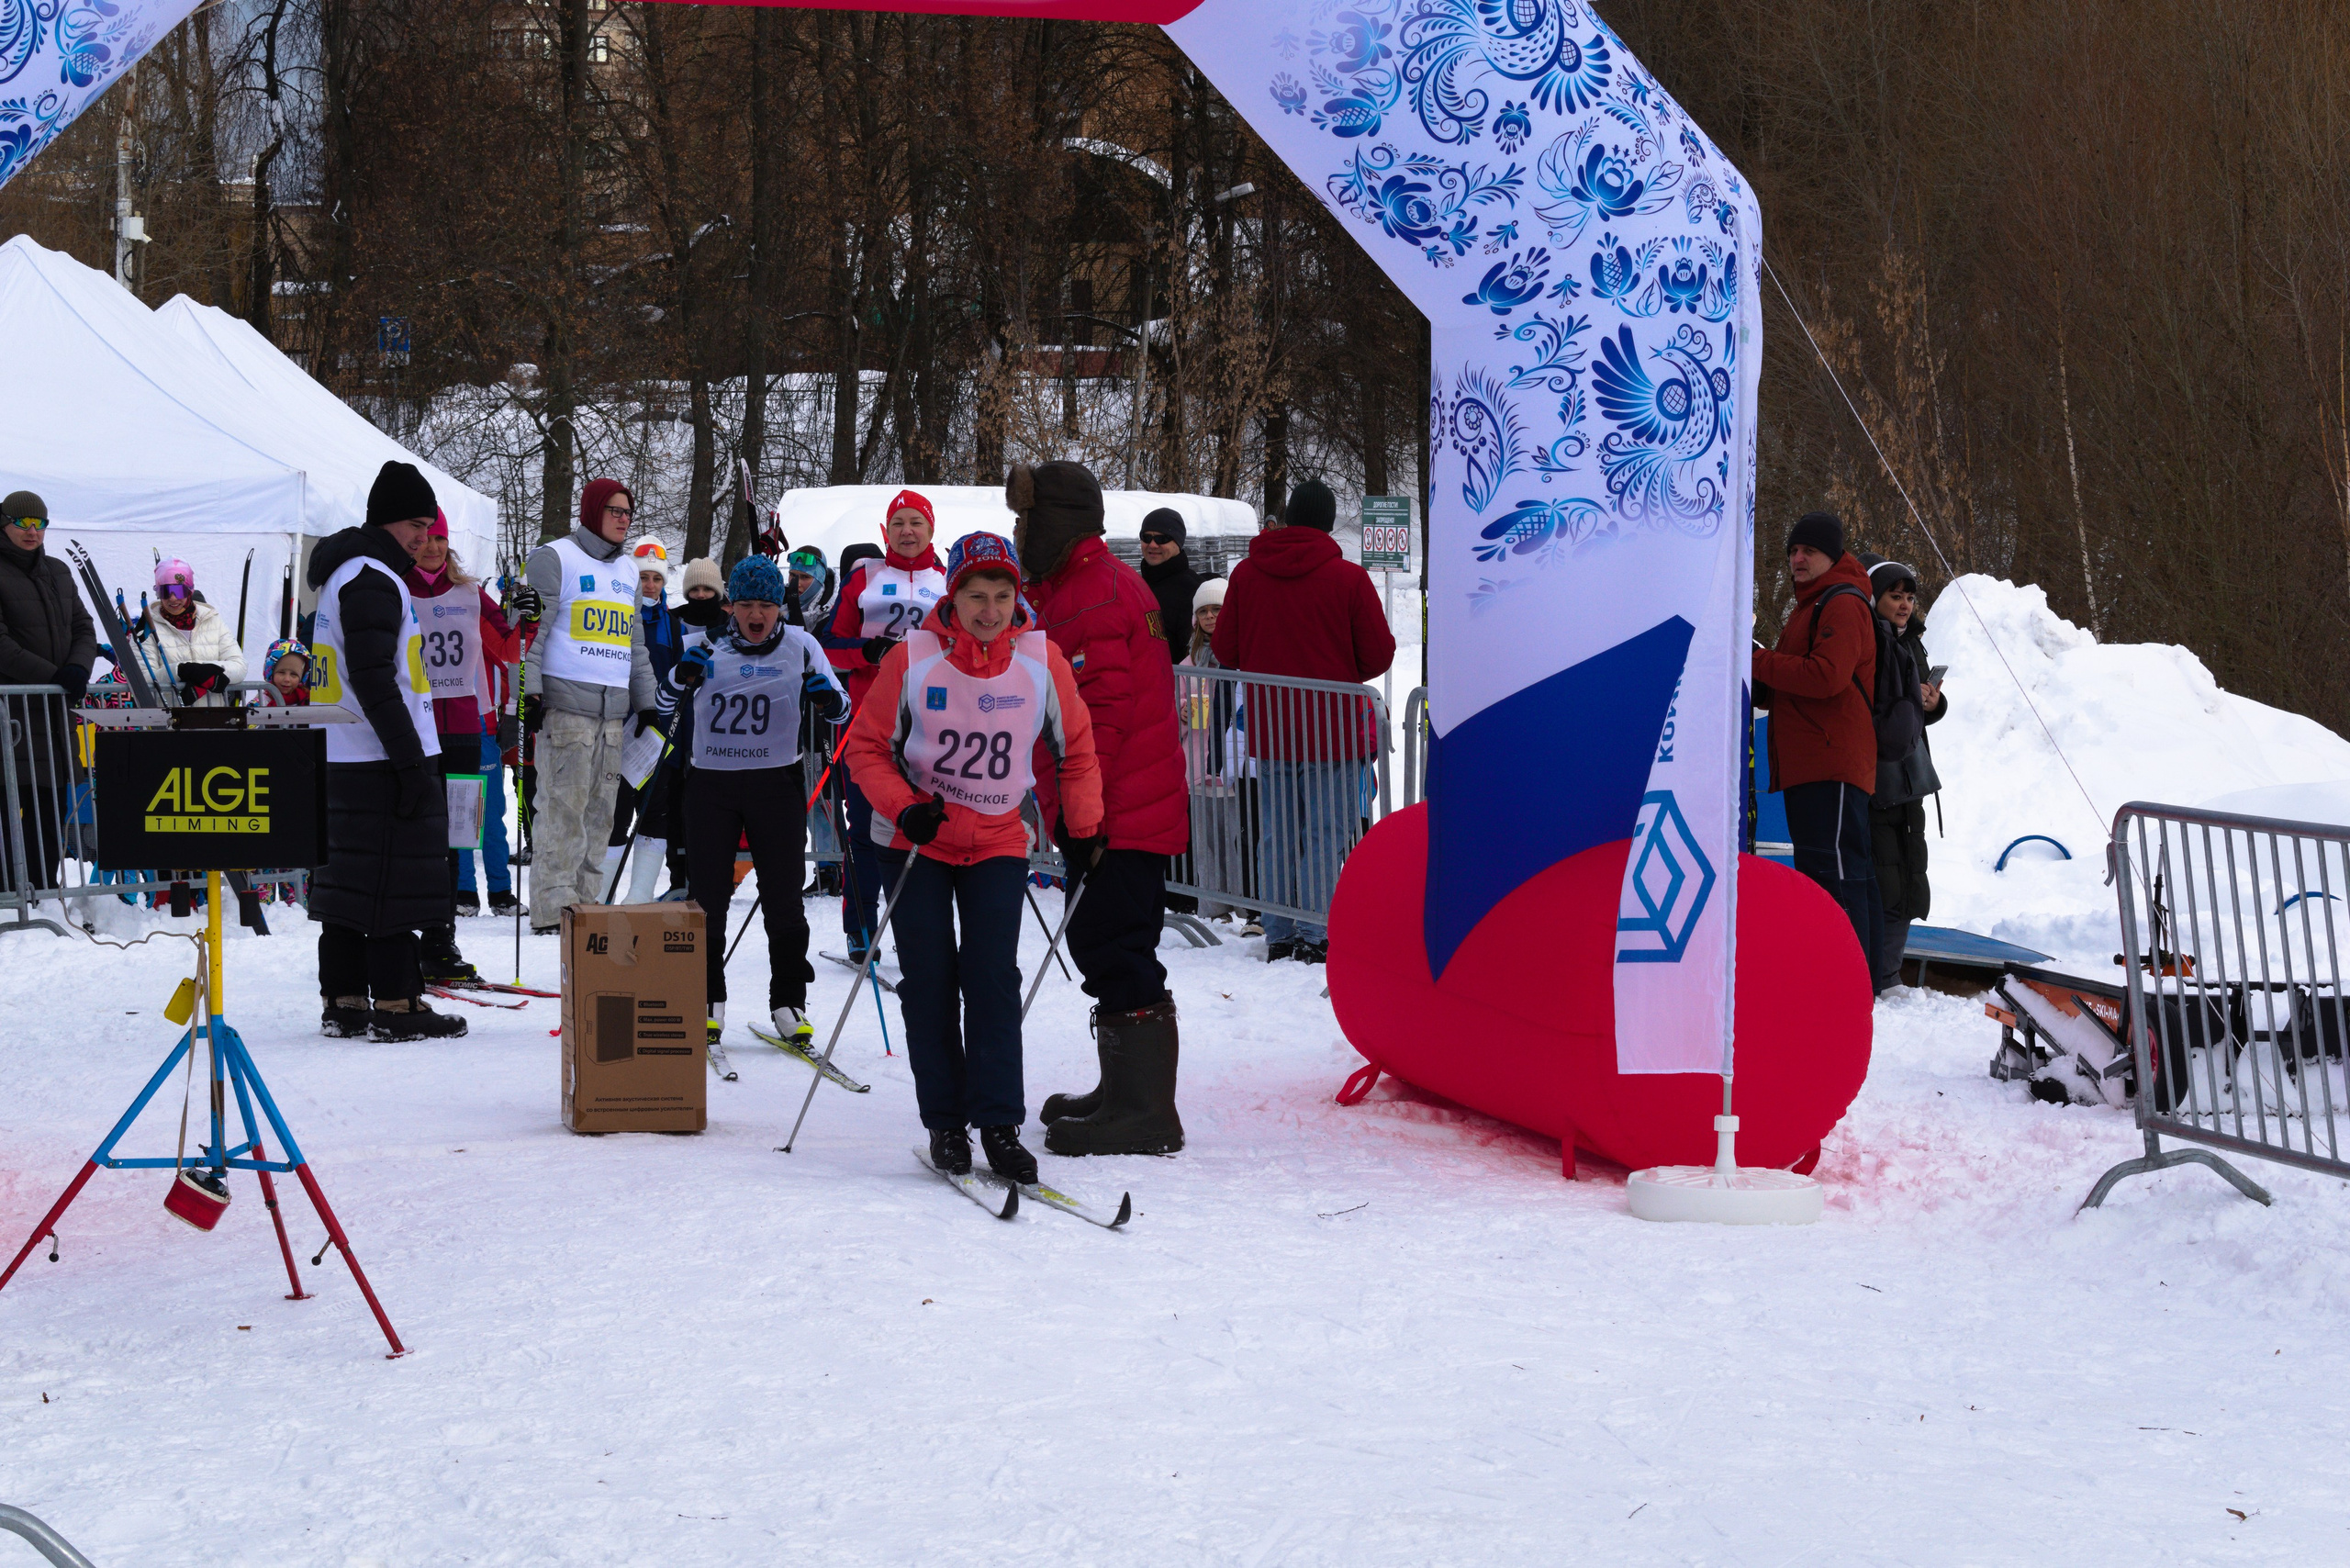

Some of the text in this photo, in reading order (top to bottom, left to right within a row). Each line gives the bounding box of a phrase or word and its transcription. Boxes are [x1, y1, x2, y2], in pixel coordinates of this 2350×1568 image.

[977, 554, 1002, 563] 2014
[582, 607, 635, 637] СУДЬЯ
[710, 693, 771, 735] 229
[706, 745, 769, 758] РАМЕНСКОЕ
[933, 729, 1013, 780] 228
[146, 766, 270, 812] ALGE
[930, 777, 1009, 804] РАМЕНСКОЕ
[156, 818, 261, 831] TIMING
[663, 931, 695, 942] DS10
[449, 980, 478, 990] ATOMIC
